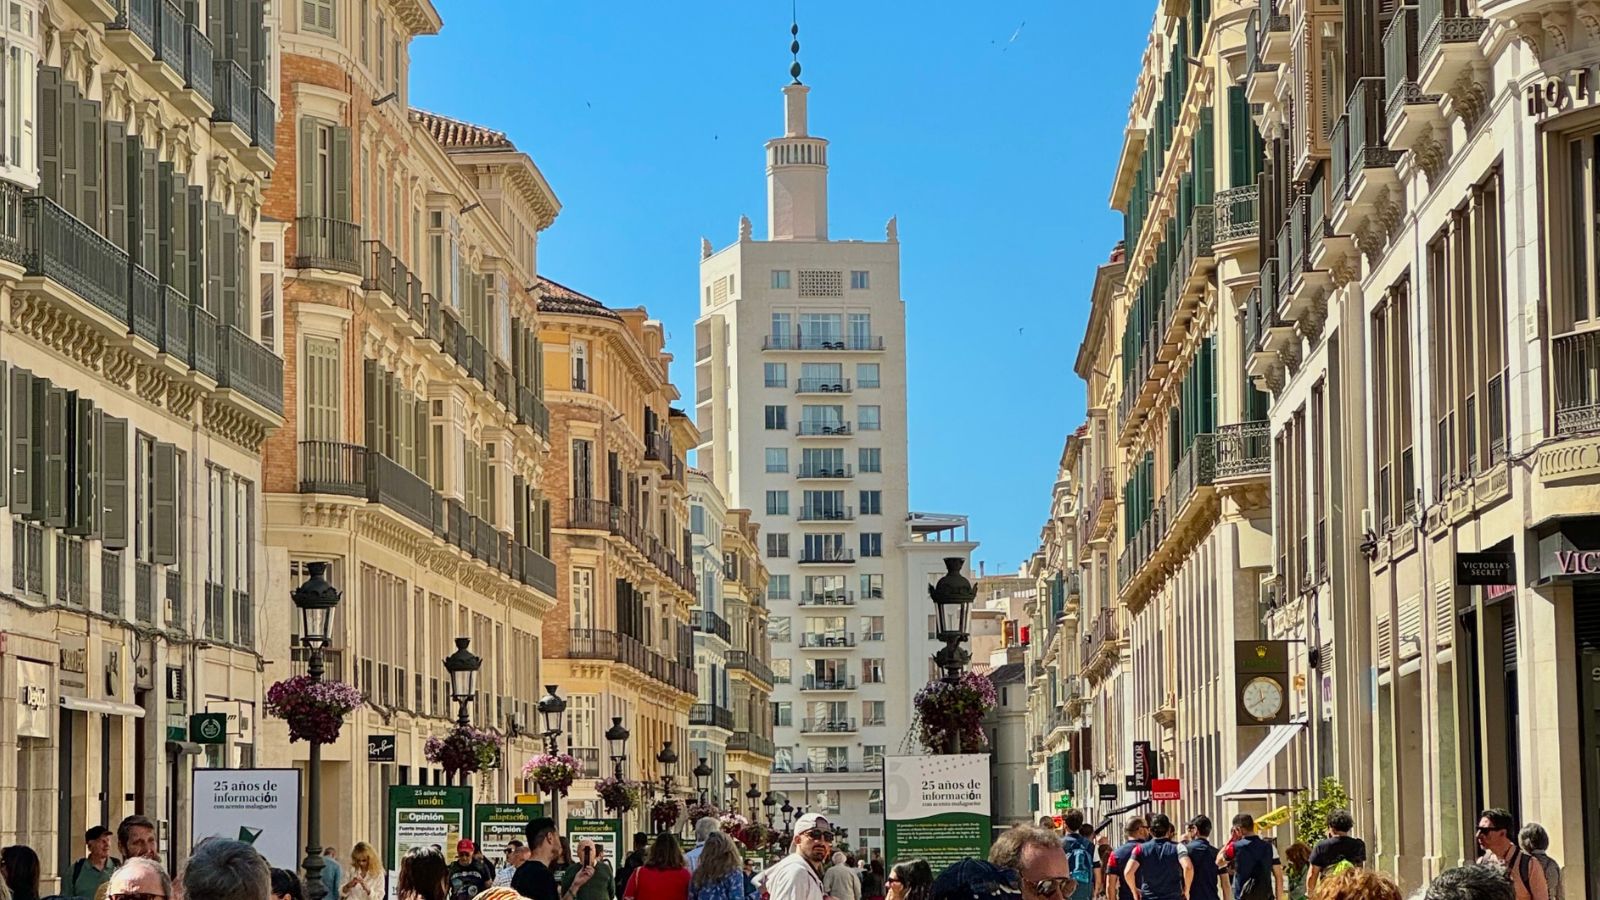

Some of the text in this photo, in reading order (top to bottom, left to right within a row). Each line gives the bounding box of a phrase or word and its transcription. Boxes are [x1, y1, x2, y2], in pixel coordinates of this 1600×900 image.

[1526, 68, 1600, 117] HOT
[1555, 550, 1600, 574] VIC
[1135, 744, 1144, 786] PRIMOR
[213, 779, 278, 791] 25 años de
[921, 779, 981, 790] 25 años de
[213, 792, 278, 803] información
[417, 796, 444, 805] unión
[922, 790, 982, 801] información
[408, 812, 444, 822] Opinión
[491, 825, 521, 833] Opinión
